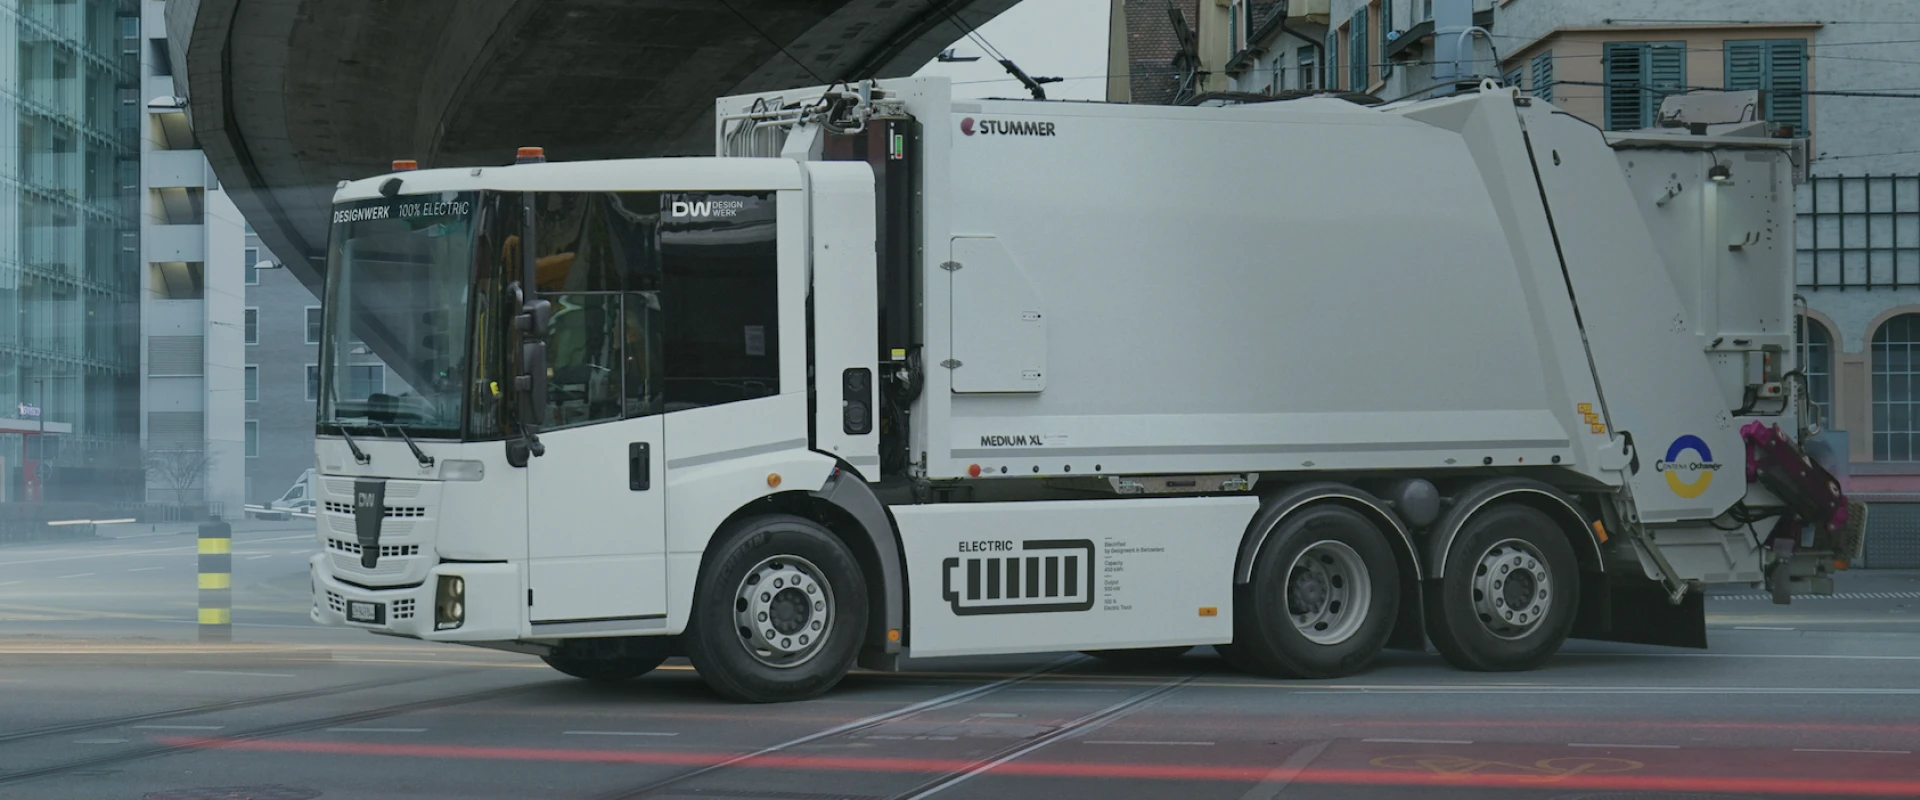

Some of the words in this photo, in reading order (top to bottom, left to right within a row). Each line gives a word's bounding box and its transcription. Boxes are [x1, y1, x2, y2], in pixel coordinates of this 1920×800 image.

[980, 119, 1056, 136] STUMMER
[333, 205, 391, 223] DESIGNWERK
[398, 203, 420, 217] 100%
[423, 201, 470, 216] ELECTRIC
[672, 201, 712, 217] DW
[712, 201, 743, 209] DESIGN
[712, 209, 737, 217] WERK
[980, 435, 1028, 447] MEDIUM
[1029, 434, 1043, 446] XL
[358, 492, 375, 507] DW
[958, 540, 1013, 552] ELECTRIC
